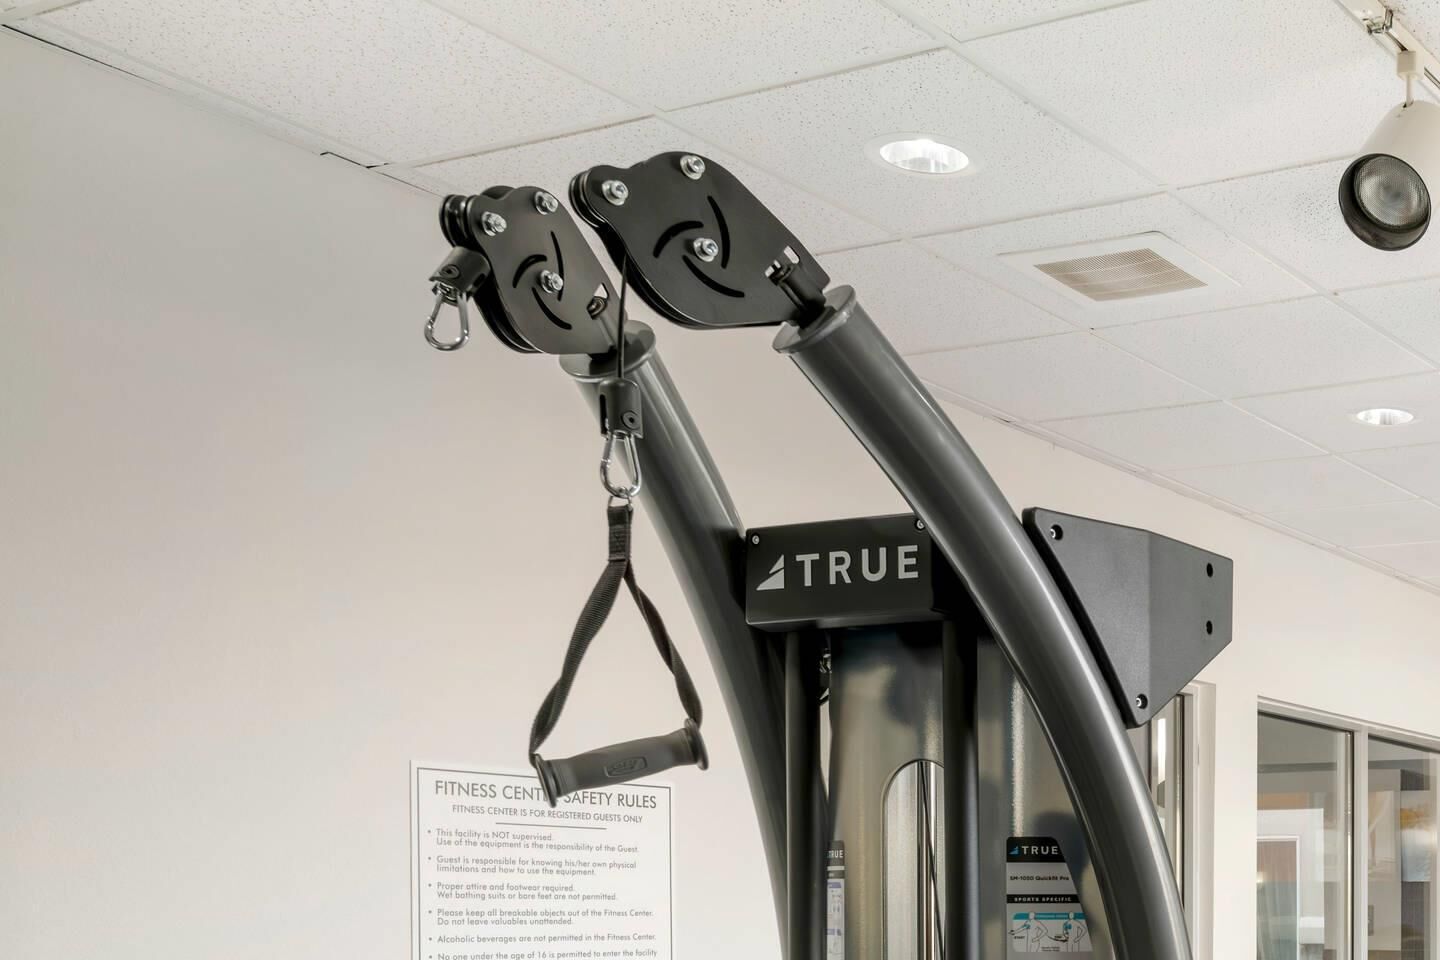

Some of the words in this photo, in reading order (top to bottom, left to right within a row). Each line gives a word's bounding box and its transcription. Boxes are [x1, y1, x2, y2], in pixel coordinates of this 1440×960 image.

[795, 544, 919, 587] TRUE
[434, 780, 497, 799] FITNESS
[502, 785, 549, 802] CENT
[564, 791, 613, 806] SAFETY
[617, 793, 657, 809] RULES
[451, 804, 484, 814] FITNESS
[487, 806, 517, 816] CENTER
[547, 810, 591, 820] REGISTERED
[592, 812, 621, 821] GUESTS
[622, 814, 642, 823] ONLY
[436, 828, 452, 836] This
[454, 829, 481, 839] facility
[479, 839, 521, 850] equipment
[545, 842, 593, 852] responsibility
[1021, 845, 1059, 855] TRUE
[436, 855, 460, 863] Guest
[471, 856, 516, 866] responsible
[531, 858, 562, 867] knowing
[608, 861, 636, 869] physical
[436, 882, 463, 891] Proper
[454, 892, 485, 900] bathing
[465, 909, 485, 918] keep
[539, 909, 565, 918] objects
[437, 935, 474, 943] Alcoholic
[476, 935, 516, 944] beverages
[547, 934, 583, 943] permitted
[556, 950, 591, 959] permitted
[635, 949, 657, 957] facility
